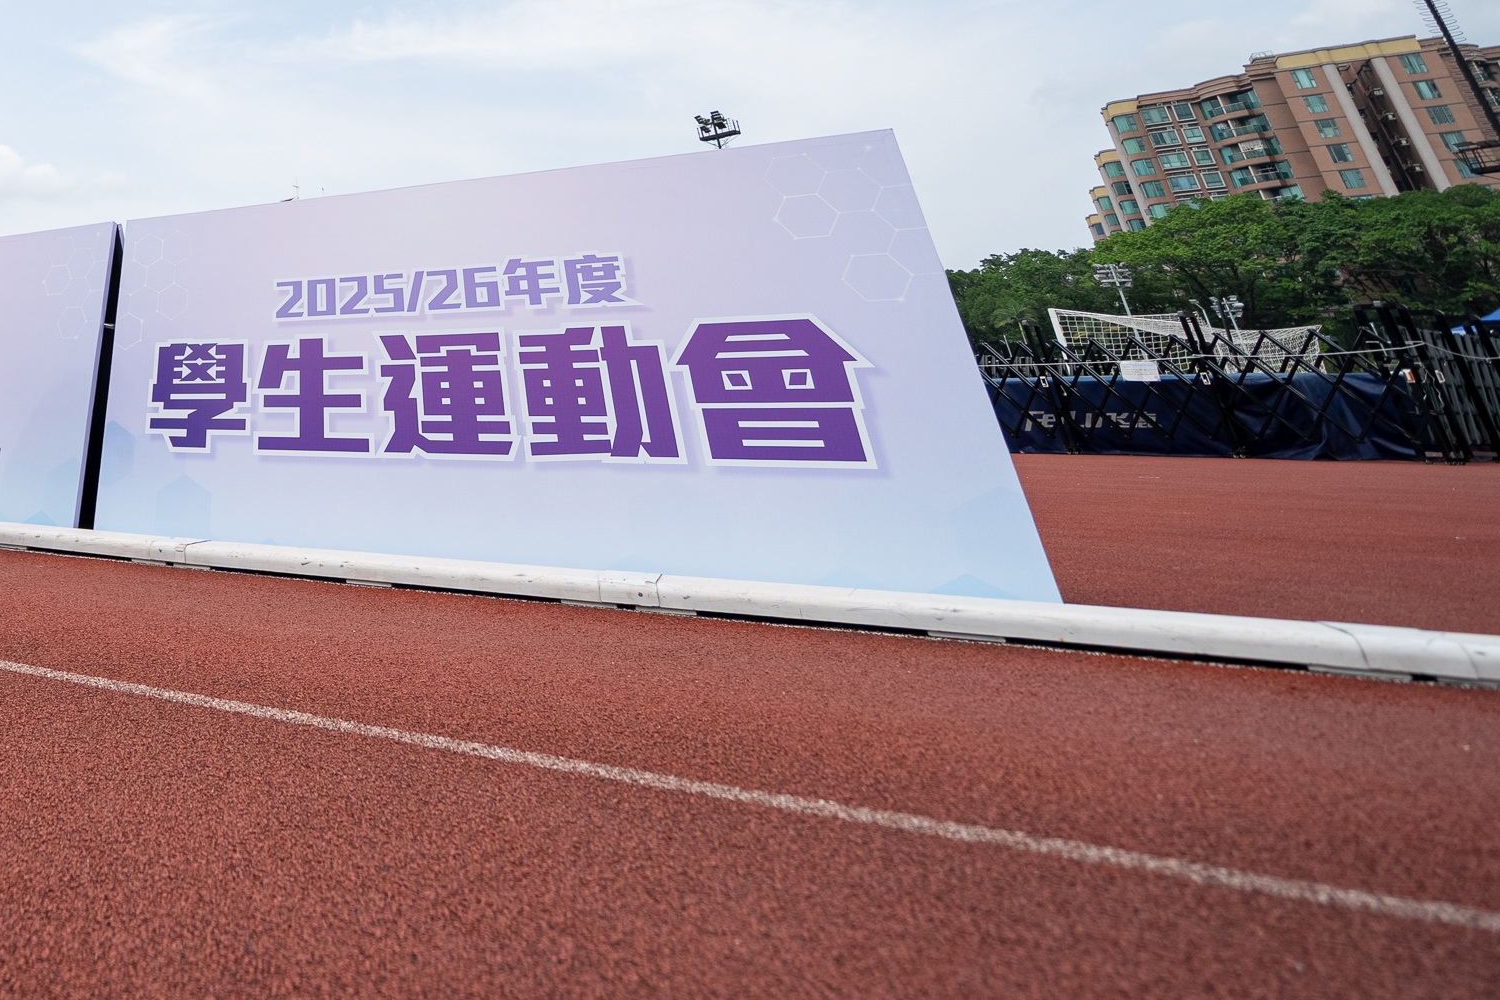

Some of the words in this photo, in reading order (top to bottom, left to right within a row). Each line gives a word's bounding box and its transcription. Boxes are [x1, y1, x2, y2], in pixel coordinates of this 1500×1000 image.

[275, 253, 628, 319] 2025/26年度
[151, 317, 870, 465] 學生運動會
